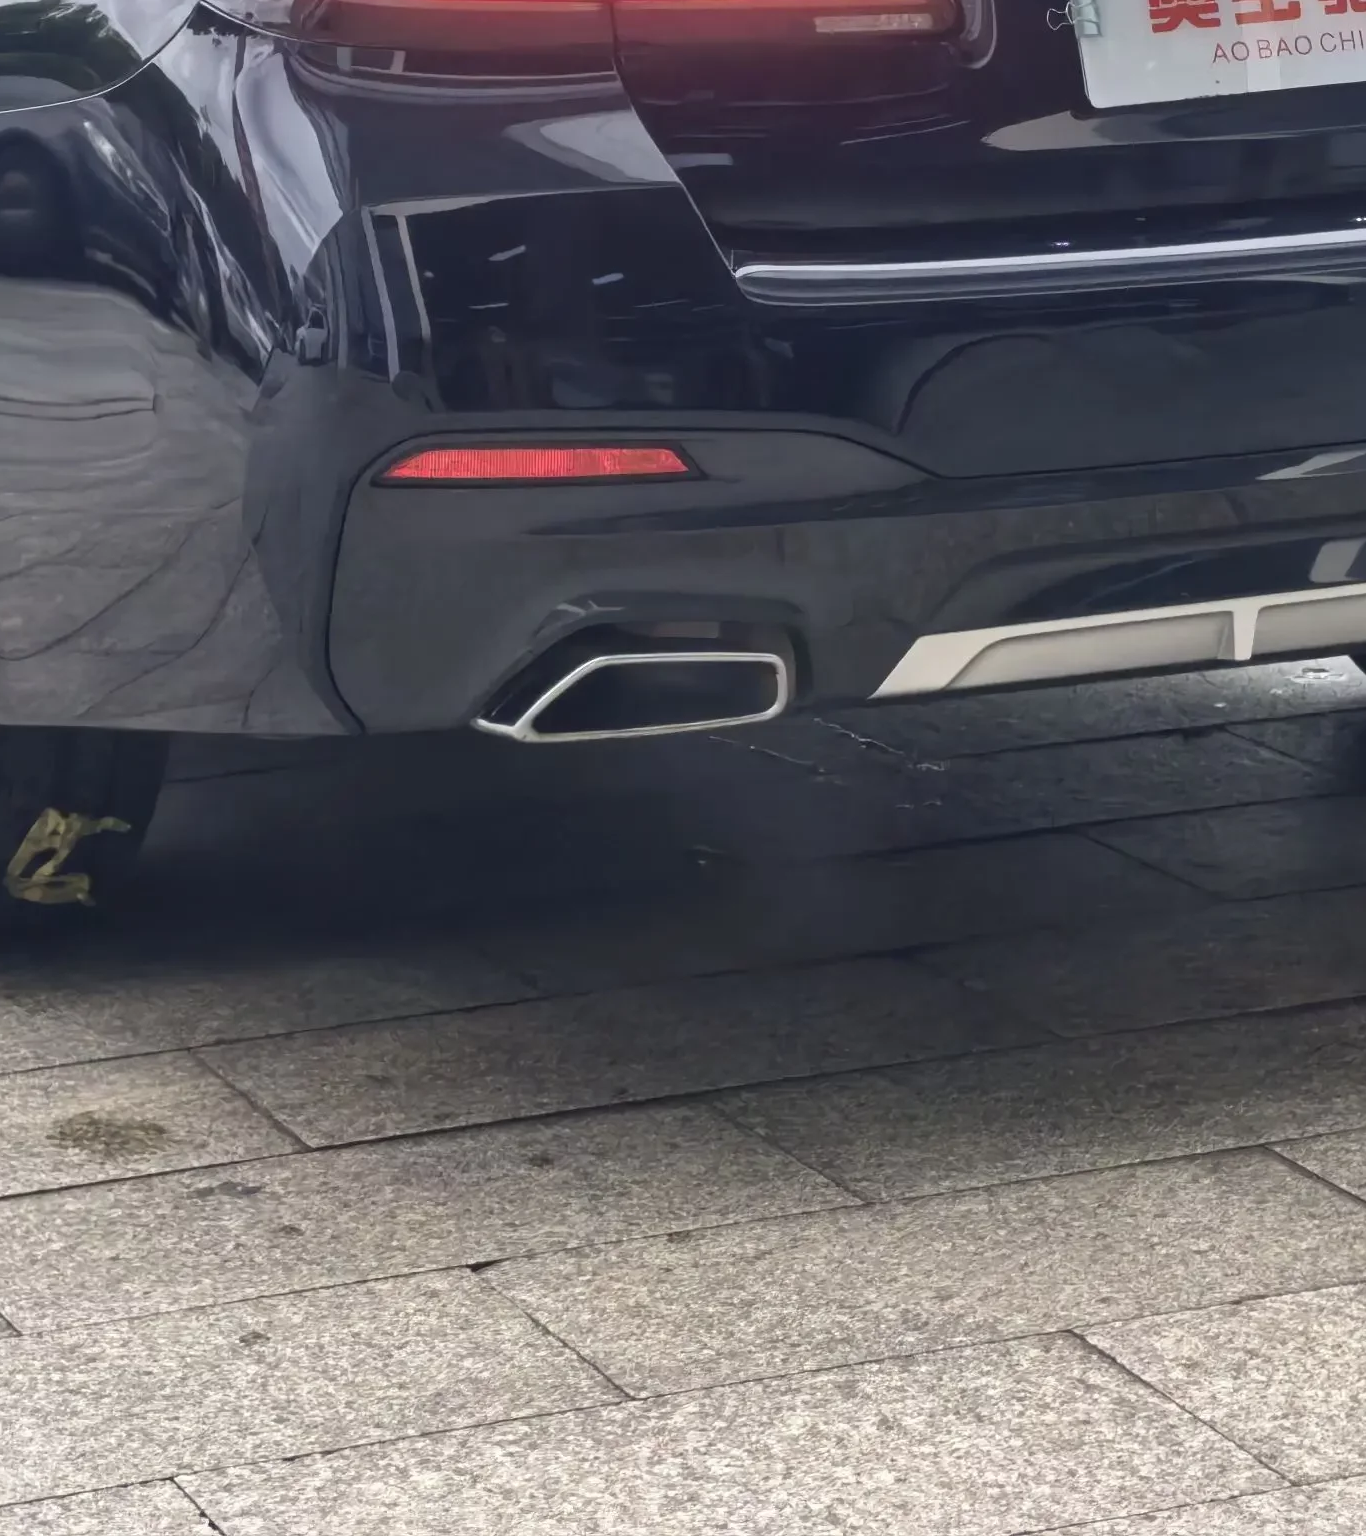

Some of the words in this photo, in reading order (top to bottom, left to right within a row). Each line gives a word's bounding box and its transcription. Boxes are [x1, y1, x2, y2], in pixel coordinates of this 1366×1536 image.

[1212, 40, 1250, 64] AO
[1256, 34, 1312, 59] BAO
[1320, 29, 1364, 53] CHI
